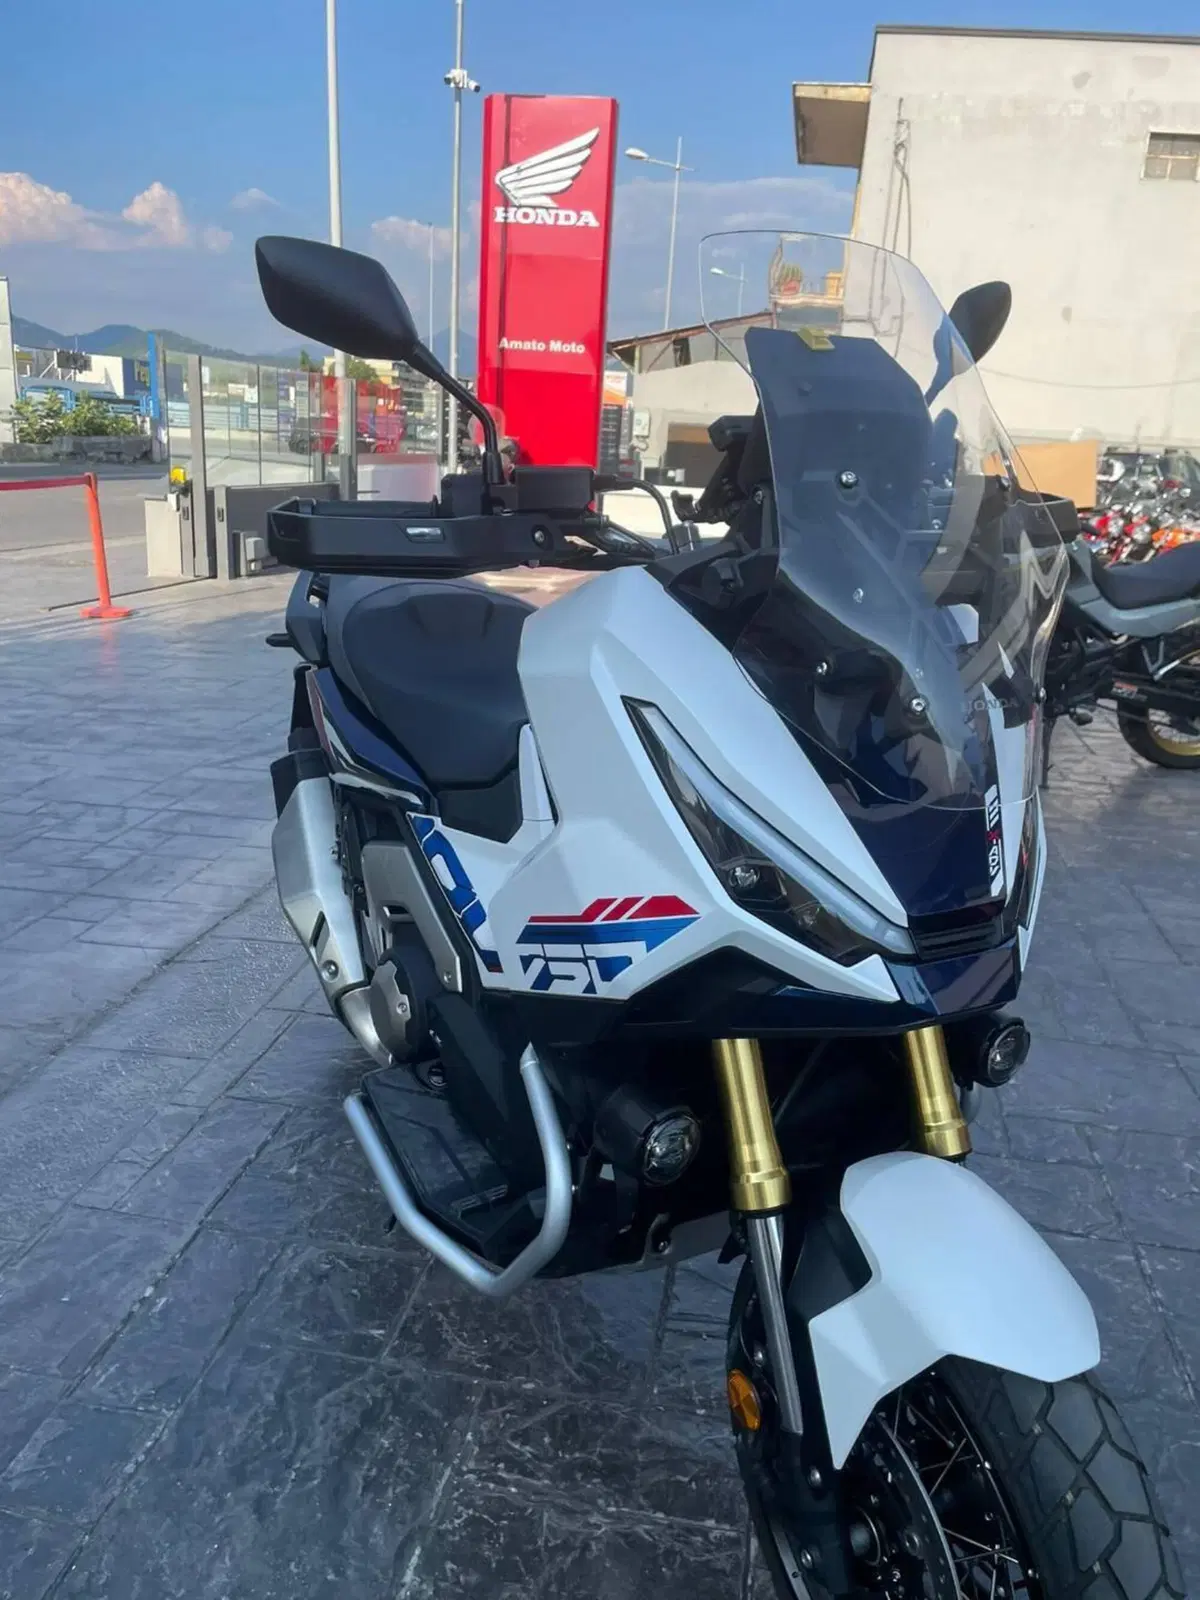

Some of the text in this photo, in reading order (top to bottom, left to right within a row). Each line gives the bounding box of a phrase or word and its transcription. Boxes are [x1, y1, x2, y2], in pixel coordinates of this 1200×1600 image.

[494, 206, 600, 227] HONDA
[499, 337, 586, 354] Amato Moto
